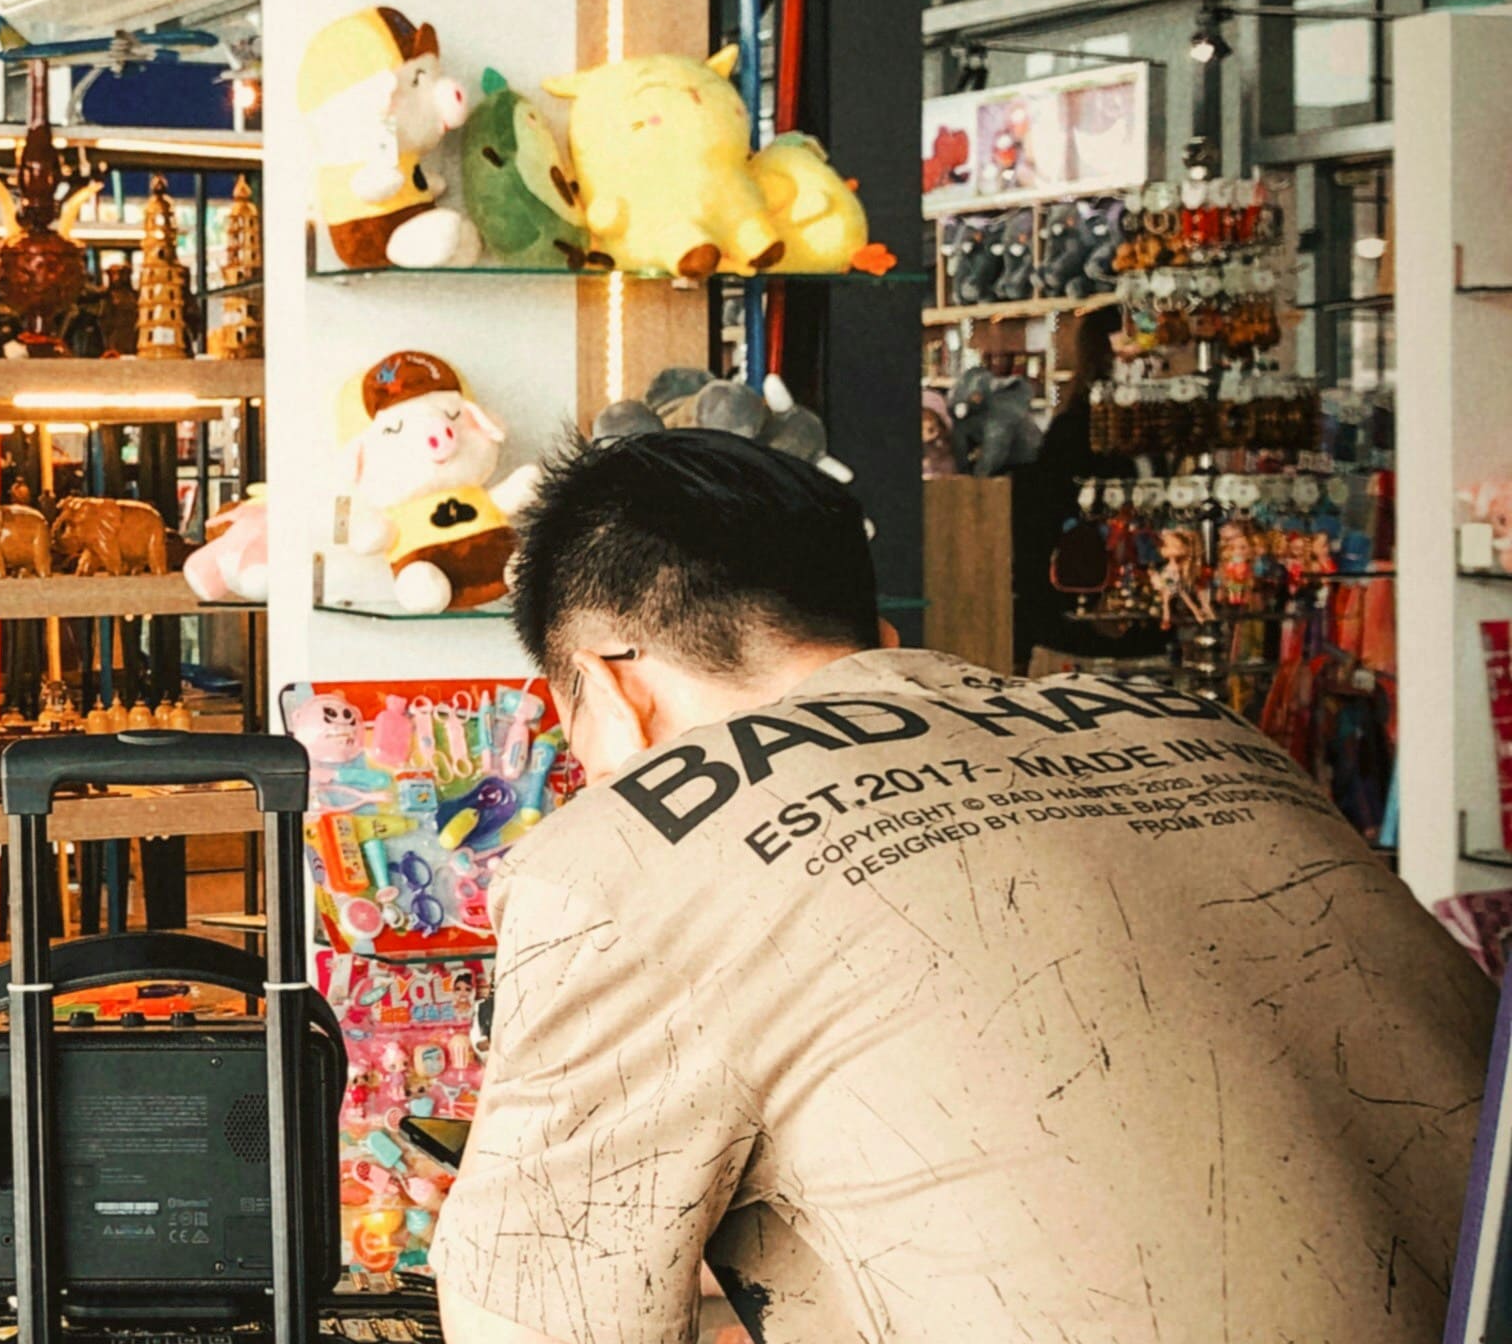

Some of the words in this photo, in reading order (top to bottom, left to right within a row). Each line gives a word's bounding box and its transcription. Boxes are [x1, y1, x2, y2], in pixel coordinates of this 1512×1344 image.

[610, 700, 929, 844] BAD
[930, 677, 1249, 736] HABI
[1007, 745, 1170, 777] MADE
[1163, 738, 1224, 762] IN
[805, 802, 956, 876] COPYRIGHT
[988, 790, 1044, 807] BAD
[1047, 783, 1139, 800] HABITS
[1200, 774, 1243, 786] ALL
[842, 821, 981, 887] DESIGNED
[985, 812, 1022, 831] BY
[1026, 803, 1133, 822] DOUBLE
[1136, 797, 1184, 814] BAD
[1128, 816, 1201, 835] FROM
[1204, 808, 1257, 826] 2017
